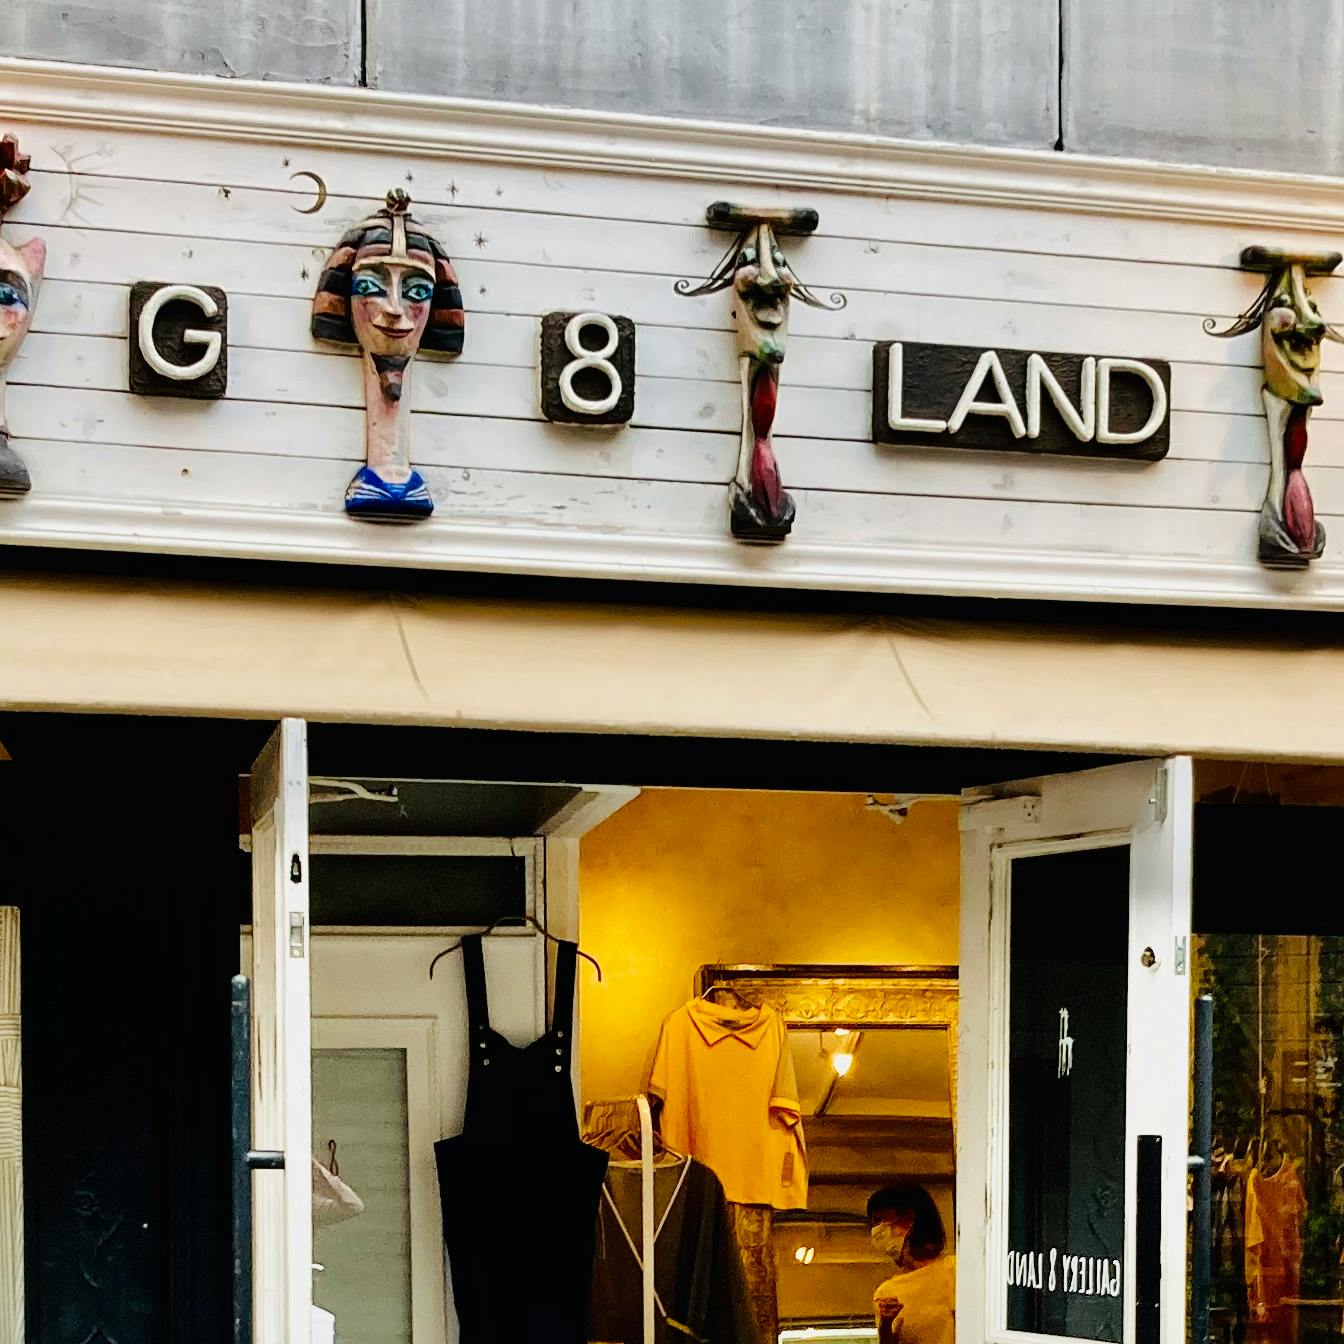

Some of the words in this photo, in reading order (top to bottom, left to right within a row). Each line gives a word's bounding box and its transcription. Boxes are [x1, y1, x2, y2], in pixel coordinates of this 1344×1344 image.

[137, 284, 223, 382] G
[558, 312, 623, 415] 8
[887, 341, 1168, 445] LAND
